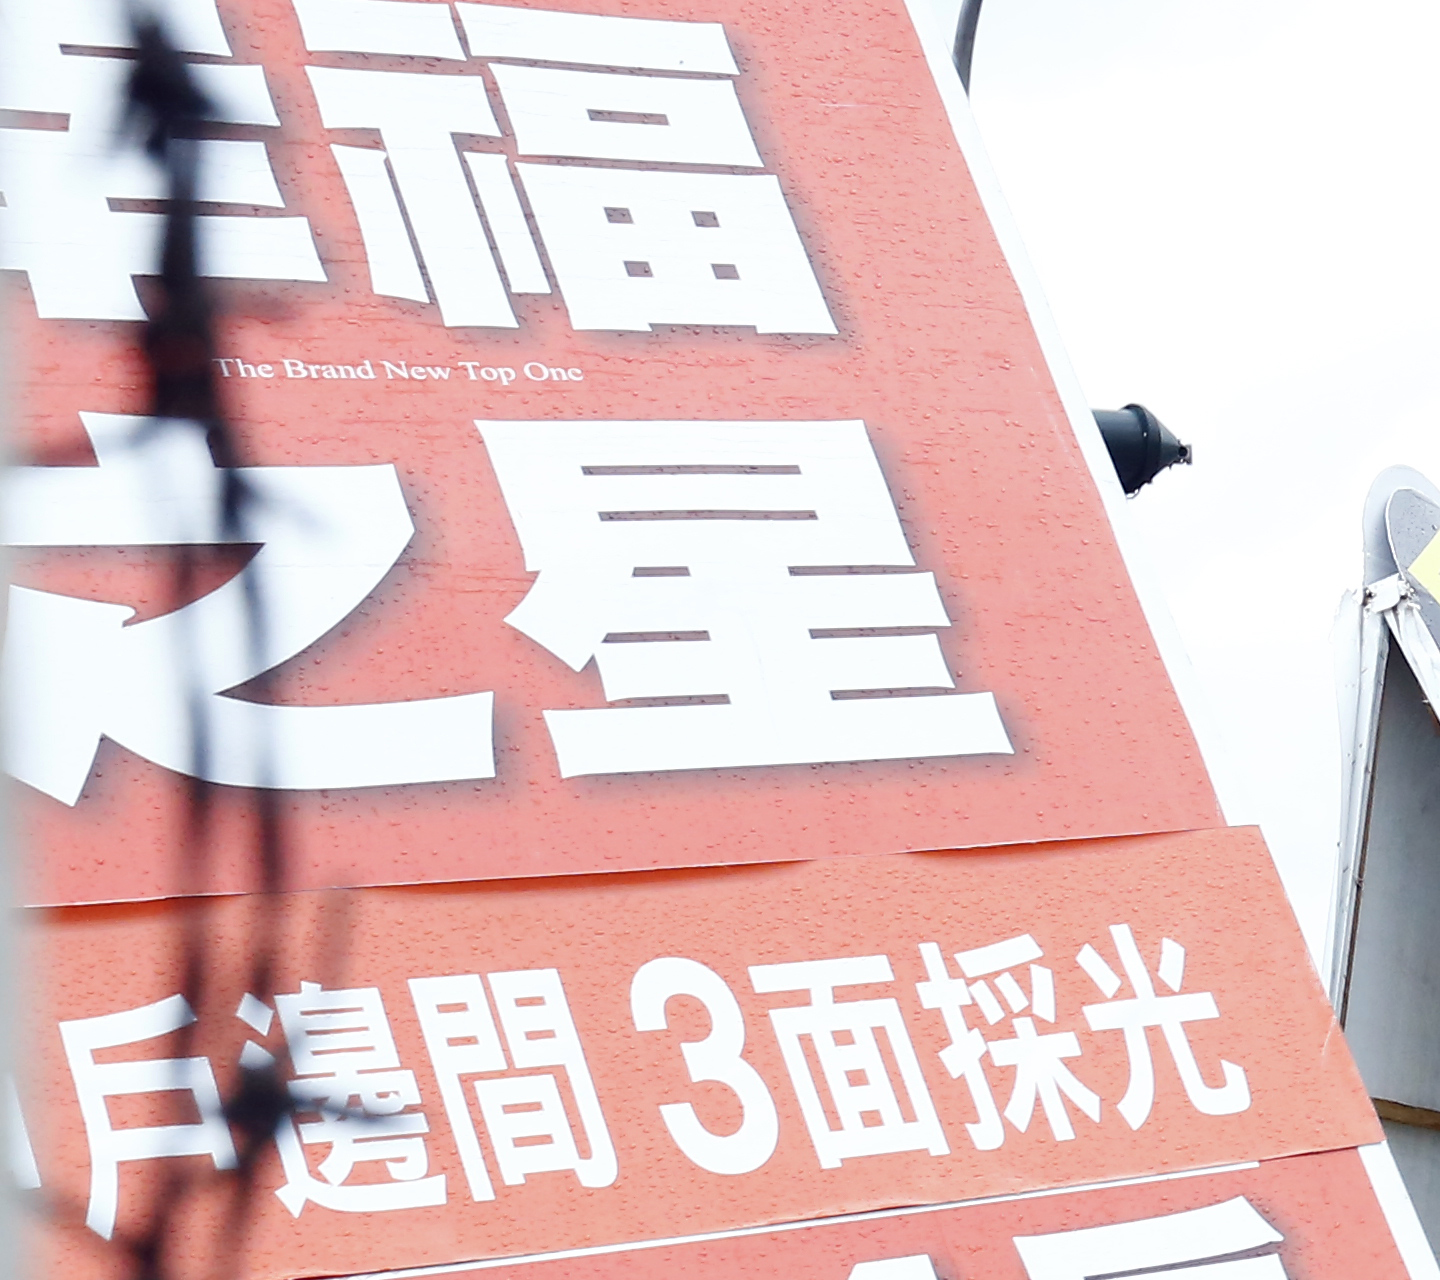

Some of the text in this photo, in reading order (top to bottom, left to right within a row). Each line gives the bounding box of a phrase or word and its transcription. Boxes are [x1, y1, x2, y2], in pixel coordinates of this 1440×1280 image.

[212, 357, 584, 385] The Brand New Top One
[0, 410, 1015, 807] 之星
[629, 923, 1252, 1174] 3面採光
